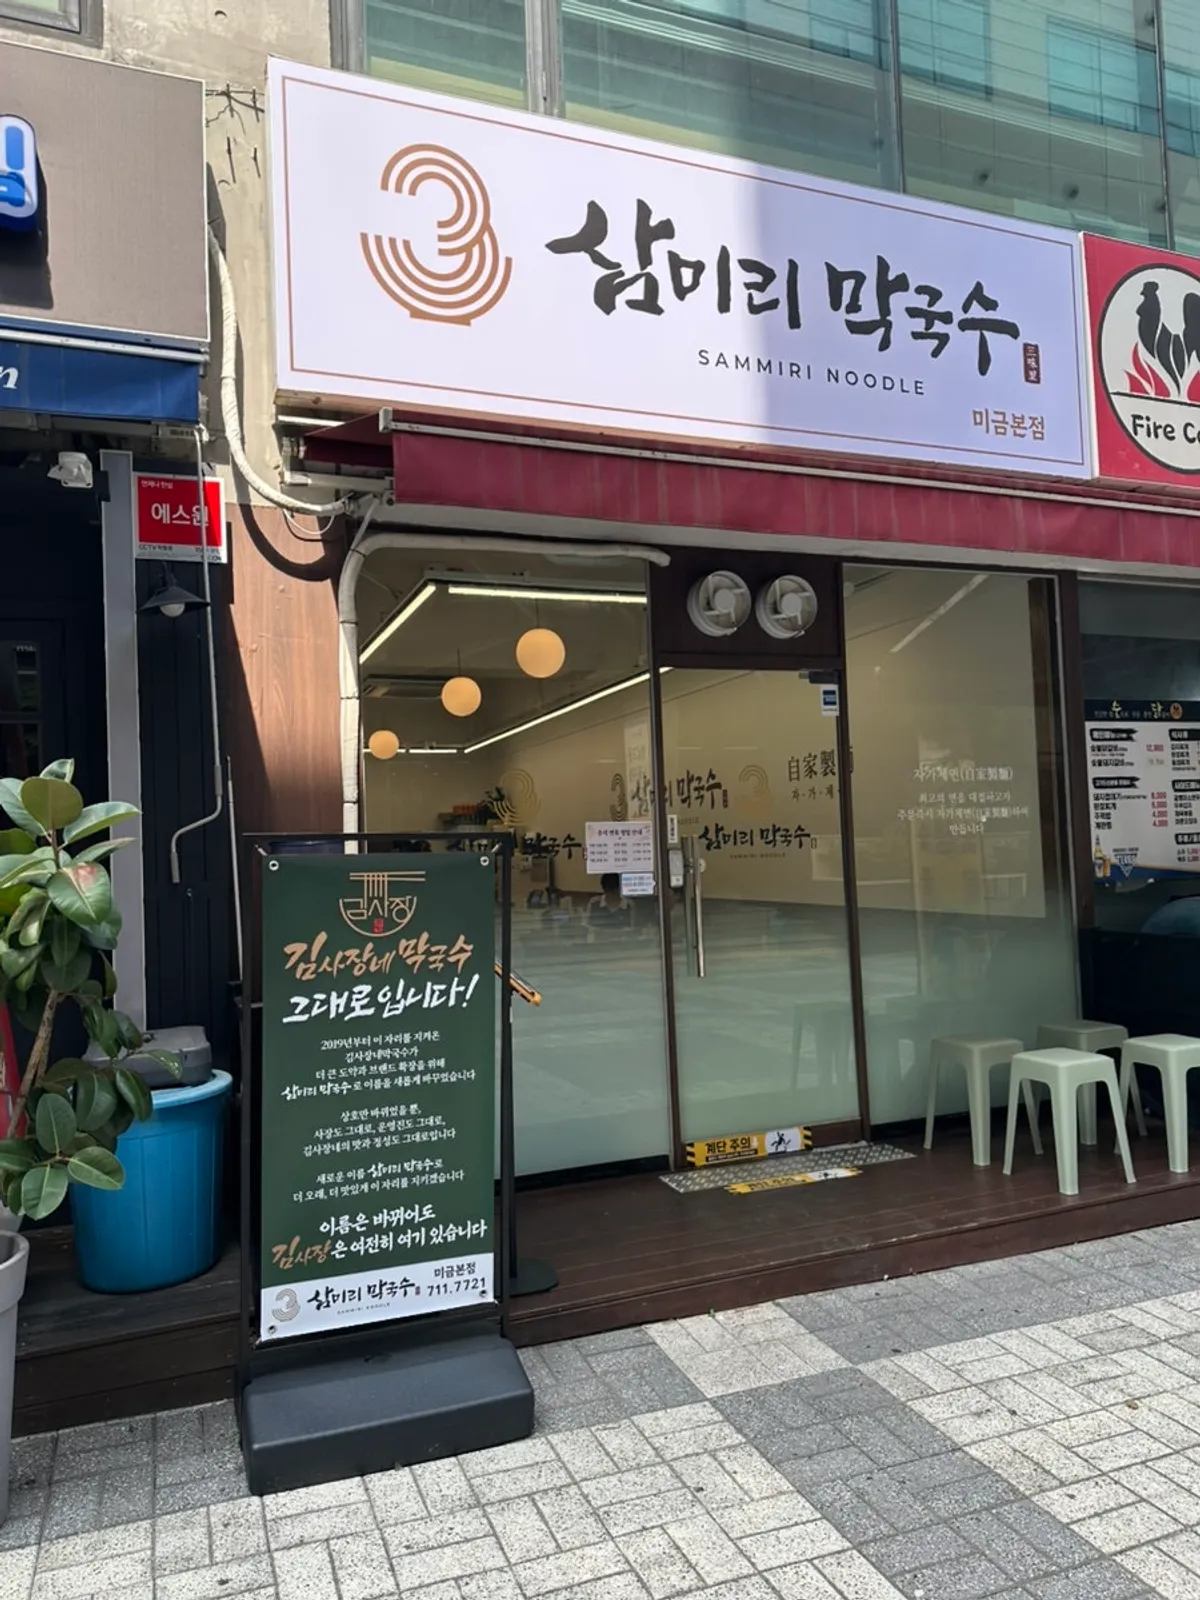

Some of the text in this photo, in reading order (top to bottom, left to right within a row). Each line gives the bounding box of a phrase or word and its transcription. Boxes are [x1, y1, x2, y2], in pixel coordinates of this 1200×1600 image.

[545, 198, 1020, 376] 삼미리 막국수
[698, 349, 925, 395] SAMMIRI NOODLE
[972, 408, 1045, 441] 미금본점
[1131, 413, 1176, 441] Fire
[151, 503, 209, 526] 에스원
[788, 748, 854, 782] 自家製
[676, 768, 723, 810] 막국수
[699, 822, 754, 851] 삼미리
[760, 823, 810, 849] 막국수
[283, 931, 474, 981] 김사장네 막국수
[321, 1030, 440, 1050] 2019년부터 이 자리를 지켜온
[315, 1057, 446, 1080] 더 큰 도약과 브랜드 확장을 위해
[281, 1084, 317, 1101] 삼미리
[363, 1078, 391, 1091] 이름을
[393, 1075, 421, 1088] 새롭게
[422, 1069, 476, 1084] 바꾸었습니다
[313, 1115, 446, 1141] 사장도 그대로, 운영진도 그대로,
[340, 1108, 369, 1122] 상호만
[370, 1105, 407, 1118] 바뀌었을
[303, 1127, 457, 1157] 김사장네의 맛과 정성도 그대로입니다
[705, 1137, 751, 1154] 계단 주의
[292, 1169, 465, 1203] 더 오래, 더 맛있게 이 자리를 지키겠습니다
[316, 1171, 345, 1185] 새로운
[346, 1168, 366, 1181] 이름
[367, 1161, 402, 1179] 삼미리
[319, 1204, 436, 1236] 이름은 바뀌어도
[350, 1231, 393, 1256] 여전히
[397, 1227, 426, 1248] 여기
[429, 1219, 488, 1244] 있습니다
[434, 1262, 476, 1279] 미금본점
[307, 1286, 362, 1311] 삼미리
[367, 1277, 416, 1300] 막국수
[426, 1278, 486, 1297] 711.7721
